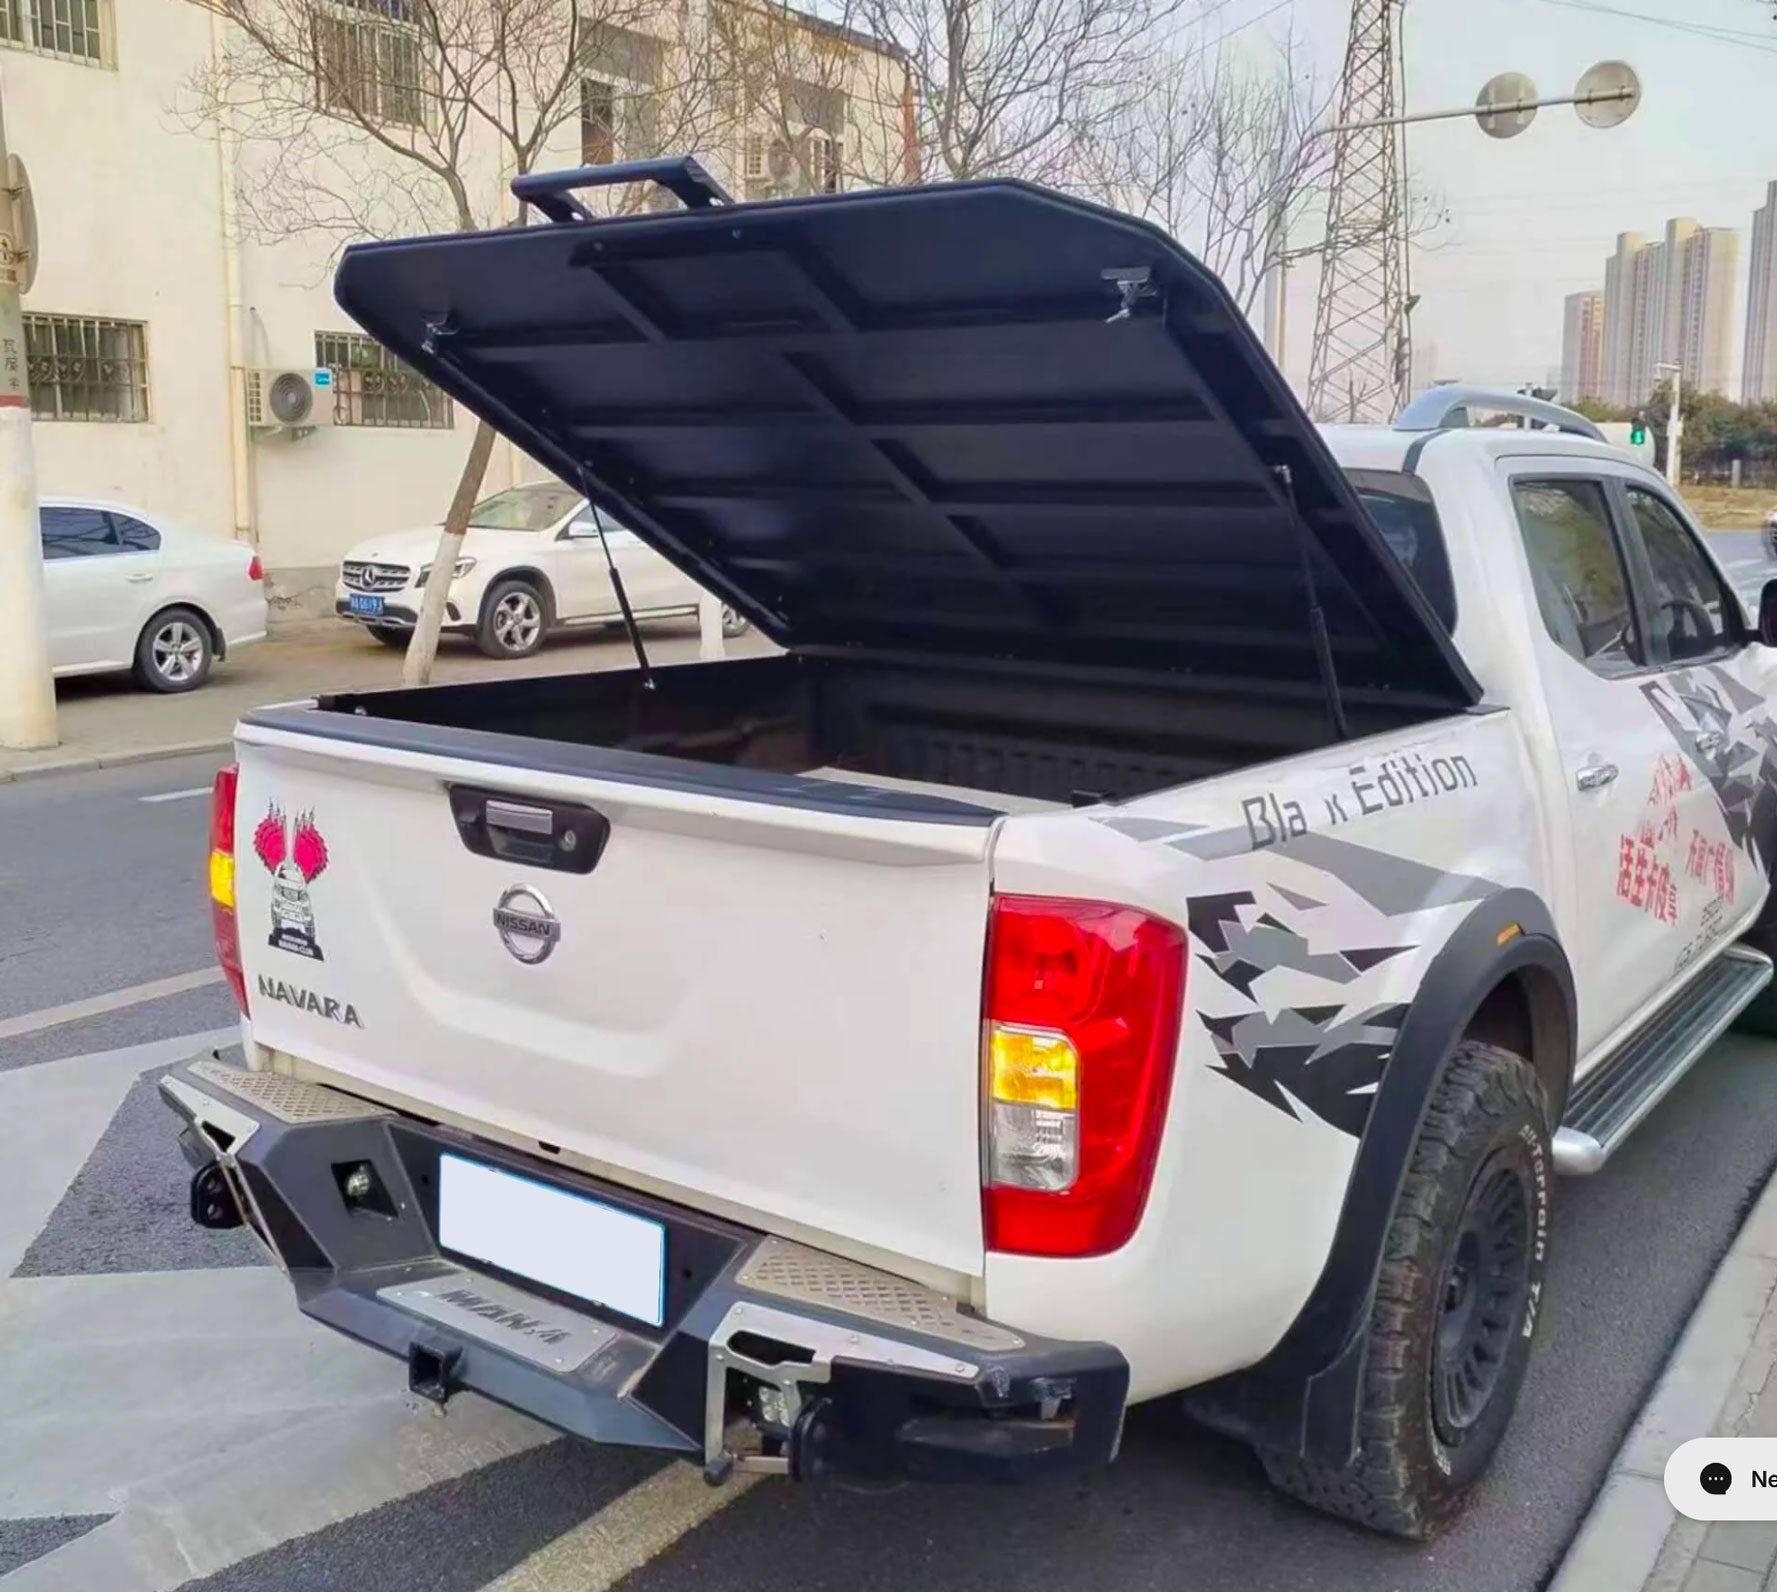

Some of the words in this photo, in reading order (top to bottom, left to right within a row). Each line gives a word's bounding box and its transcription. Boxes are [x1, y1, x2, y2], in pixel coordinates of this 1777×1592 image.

[1350, 753, 1478, 816] Edition
[497, 912, 551, 937] NISSAN
[258, 973, 366, 1030] NAVARA
